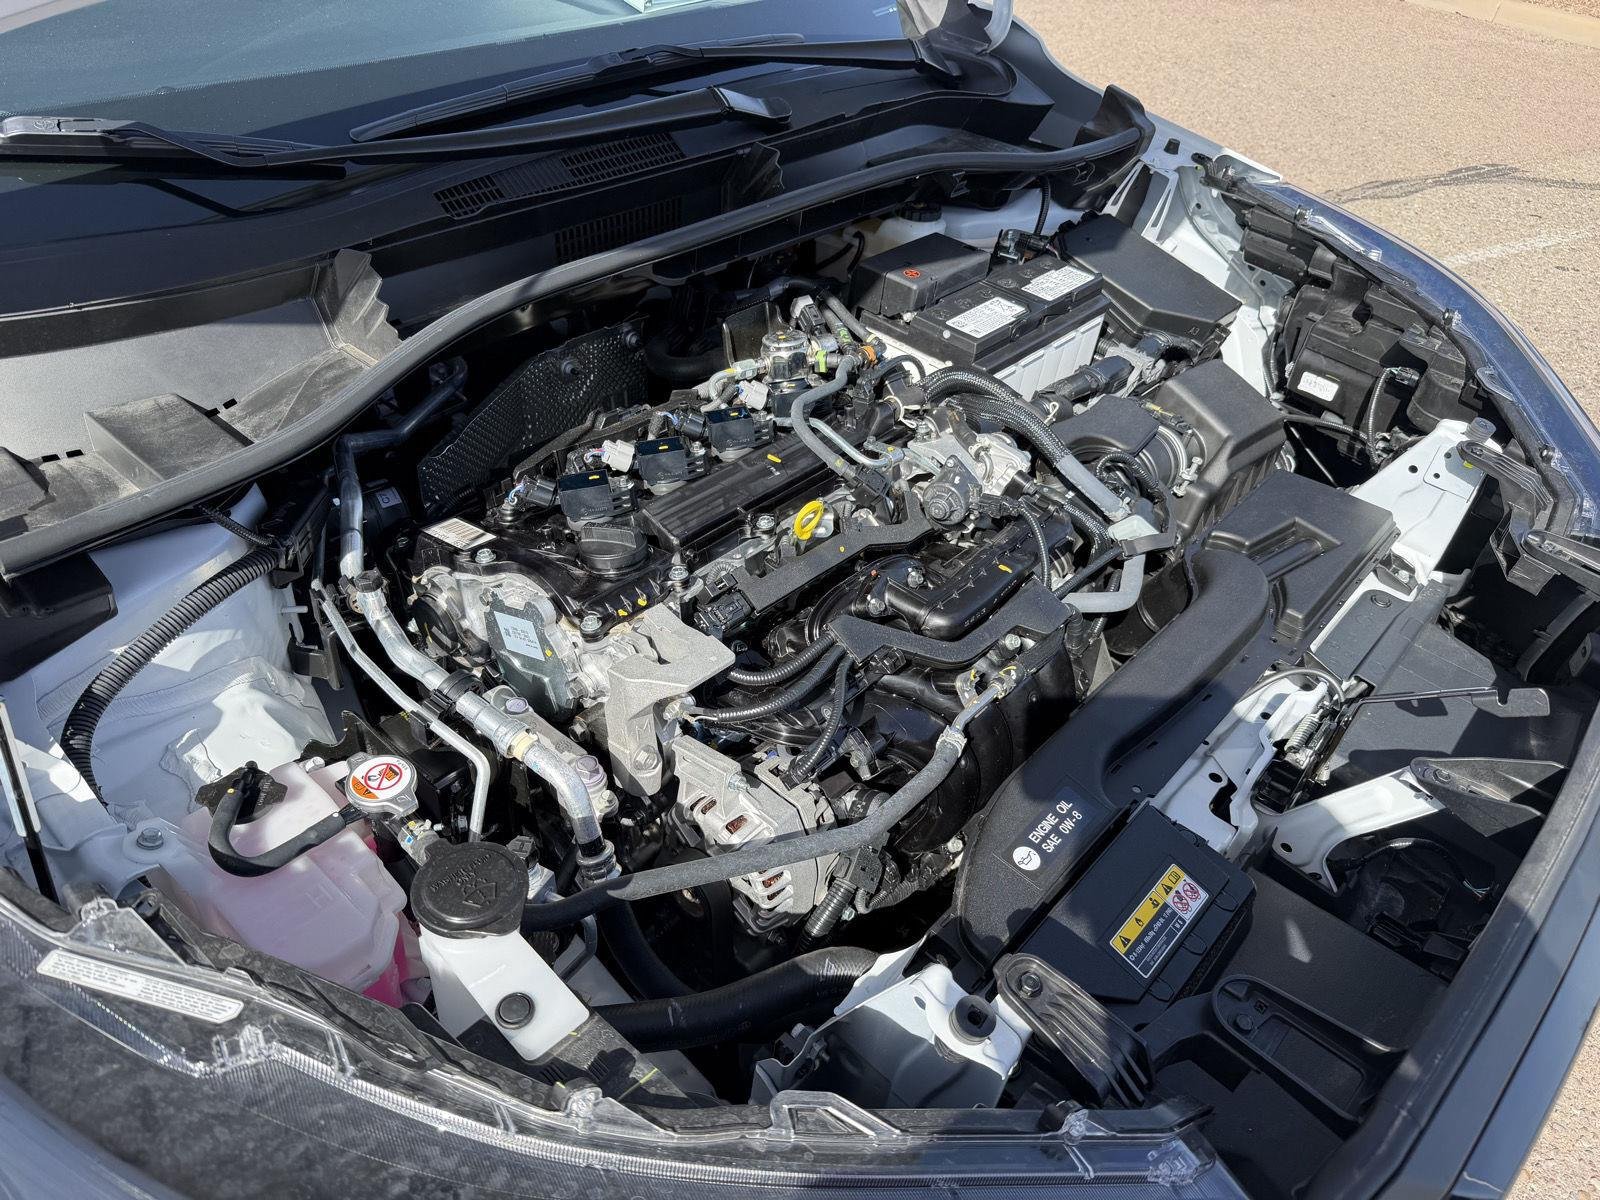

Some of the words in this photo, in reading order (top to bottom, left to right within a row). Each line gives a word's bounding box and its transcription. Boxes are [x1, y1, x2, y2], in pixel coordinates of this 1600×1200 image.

[1028, 813, 1060, 844] ENGINE
[1055, 800, 1074, 814] OIL
[1041, 833, 1062, 853] SAE
[1059, 810, 1083, 834] 0W-8
[456, 871, 477, 887] ONLY
